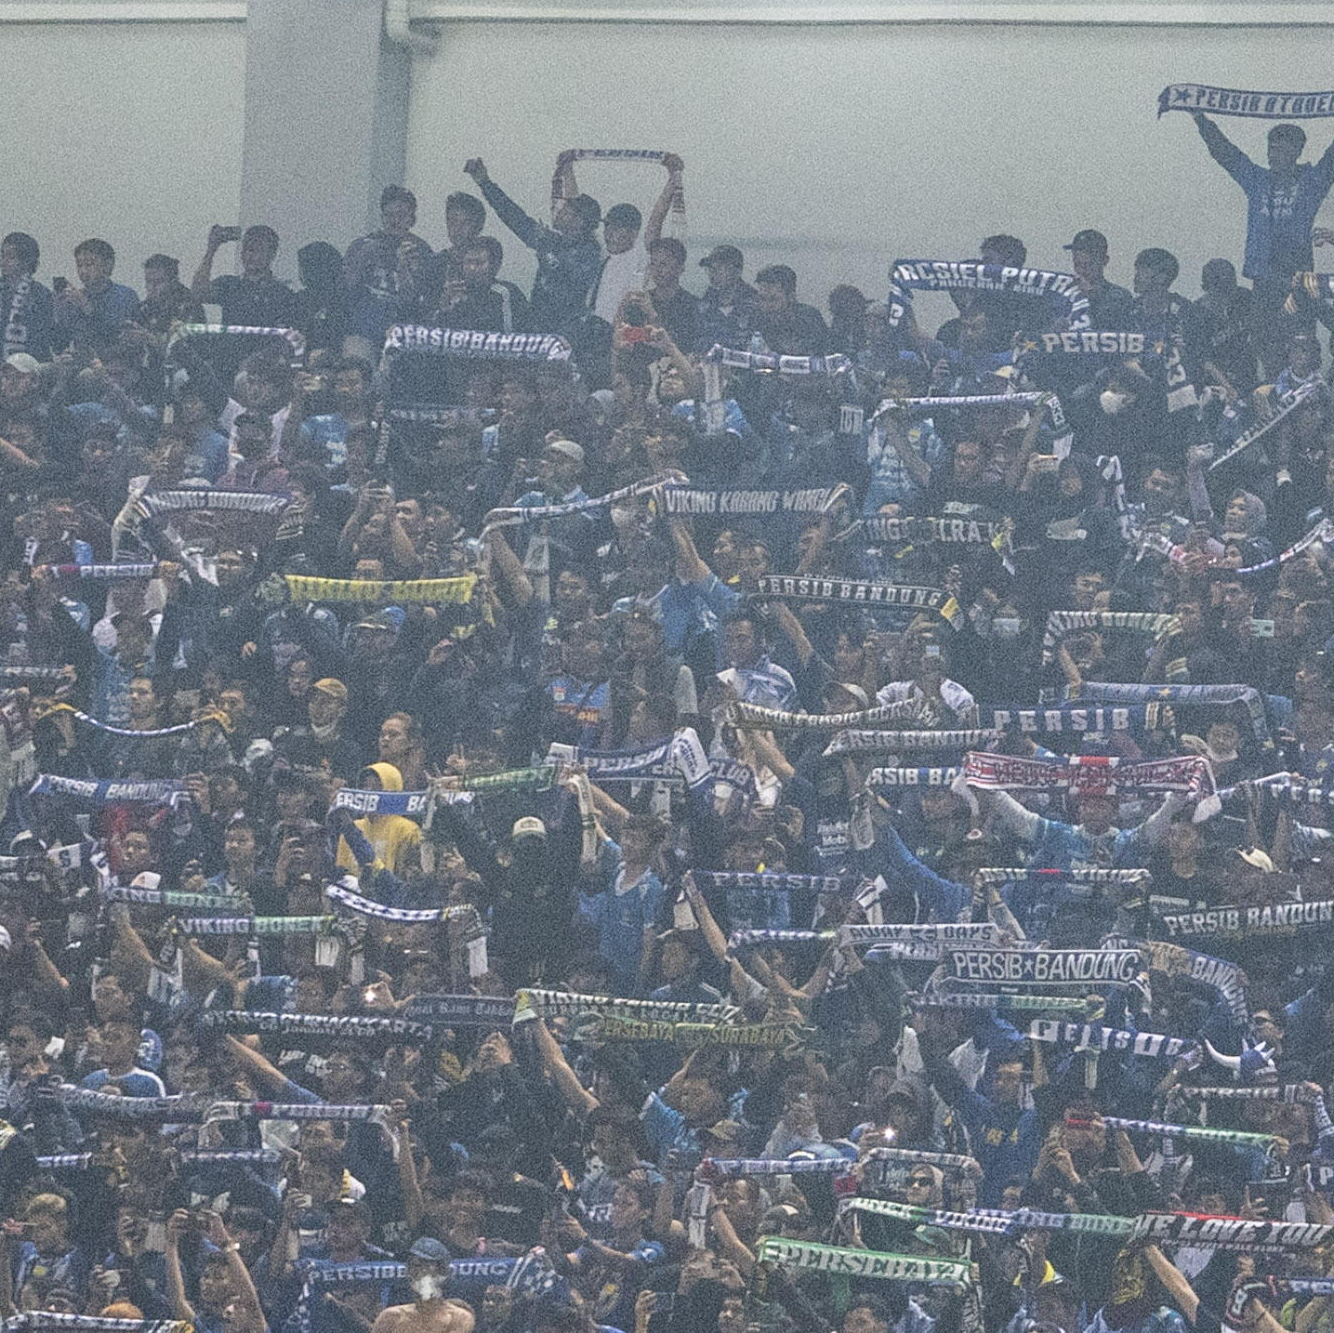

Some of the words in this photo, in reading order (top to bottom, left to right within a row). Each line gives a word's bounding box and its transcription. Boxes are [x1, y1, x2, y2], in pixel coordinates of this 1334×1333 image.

[1196, 94, 1261, 113] PERSIB
[1042, 333, 1145, 353] PERSIB
[665, 490, 716, 513] VIKING
[758, 577, 834, 597] PERSIB
[840, 584, 942, 608] BANDUNG
[993, 706, 1130, 732] PERSIB
[335, 791, 380, 812] ERSIB
[711, 871, 841, 891] PERSIB
[178, 917, 251, 935] VIKING
[1163, 908, 1240, 936] PERSIB
[952, 951, 1024, 981] PERSIB
[1035, 950, 1140, 981] BANDUNG
[1178, 1216, 1264, 1242] LOVE
[1265, 1222, 1334, 1245] YOU
[307, 1266, 395, 1284] PERSIB
